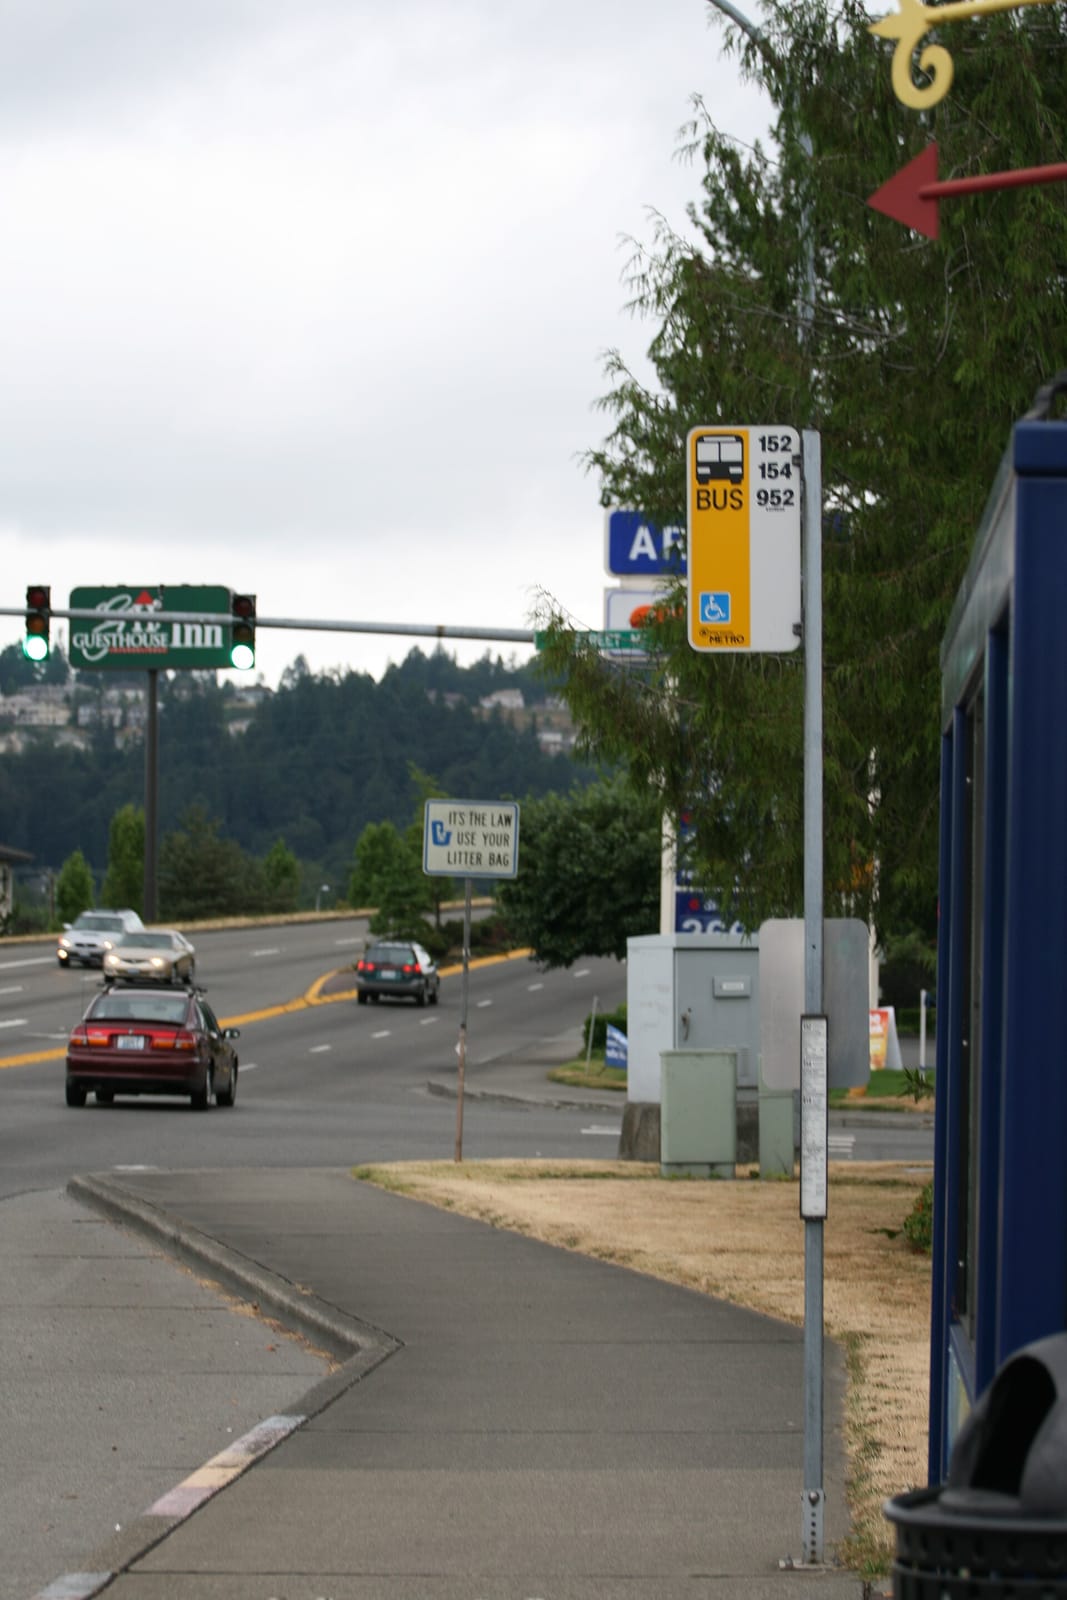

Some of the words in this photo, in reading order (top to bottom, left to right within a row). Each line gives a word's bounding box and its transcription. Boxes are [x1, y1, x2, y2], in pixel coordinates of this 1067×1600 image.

[758, 436, 792, 452] 152
[758, 463, 792, 479] 154
[697, 489, 743, 510] BUS
[757, 489, 794, 506] 952
[709, 634, 745, 644] METRO
[469, 811, 487, 827] THE
[491, 813, 512, 828] LAW
[457, 832, 476, 846] USE
[483, 833, 510, 847] YOUR
[447, 851, 482, 866] LITTER
[489, 852, 509, 866] BAG
